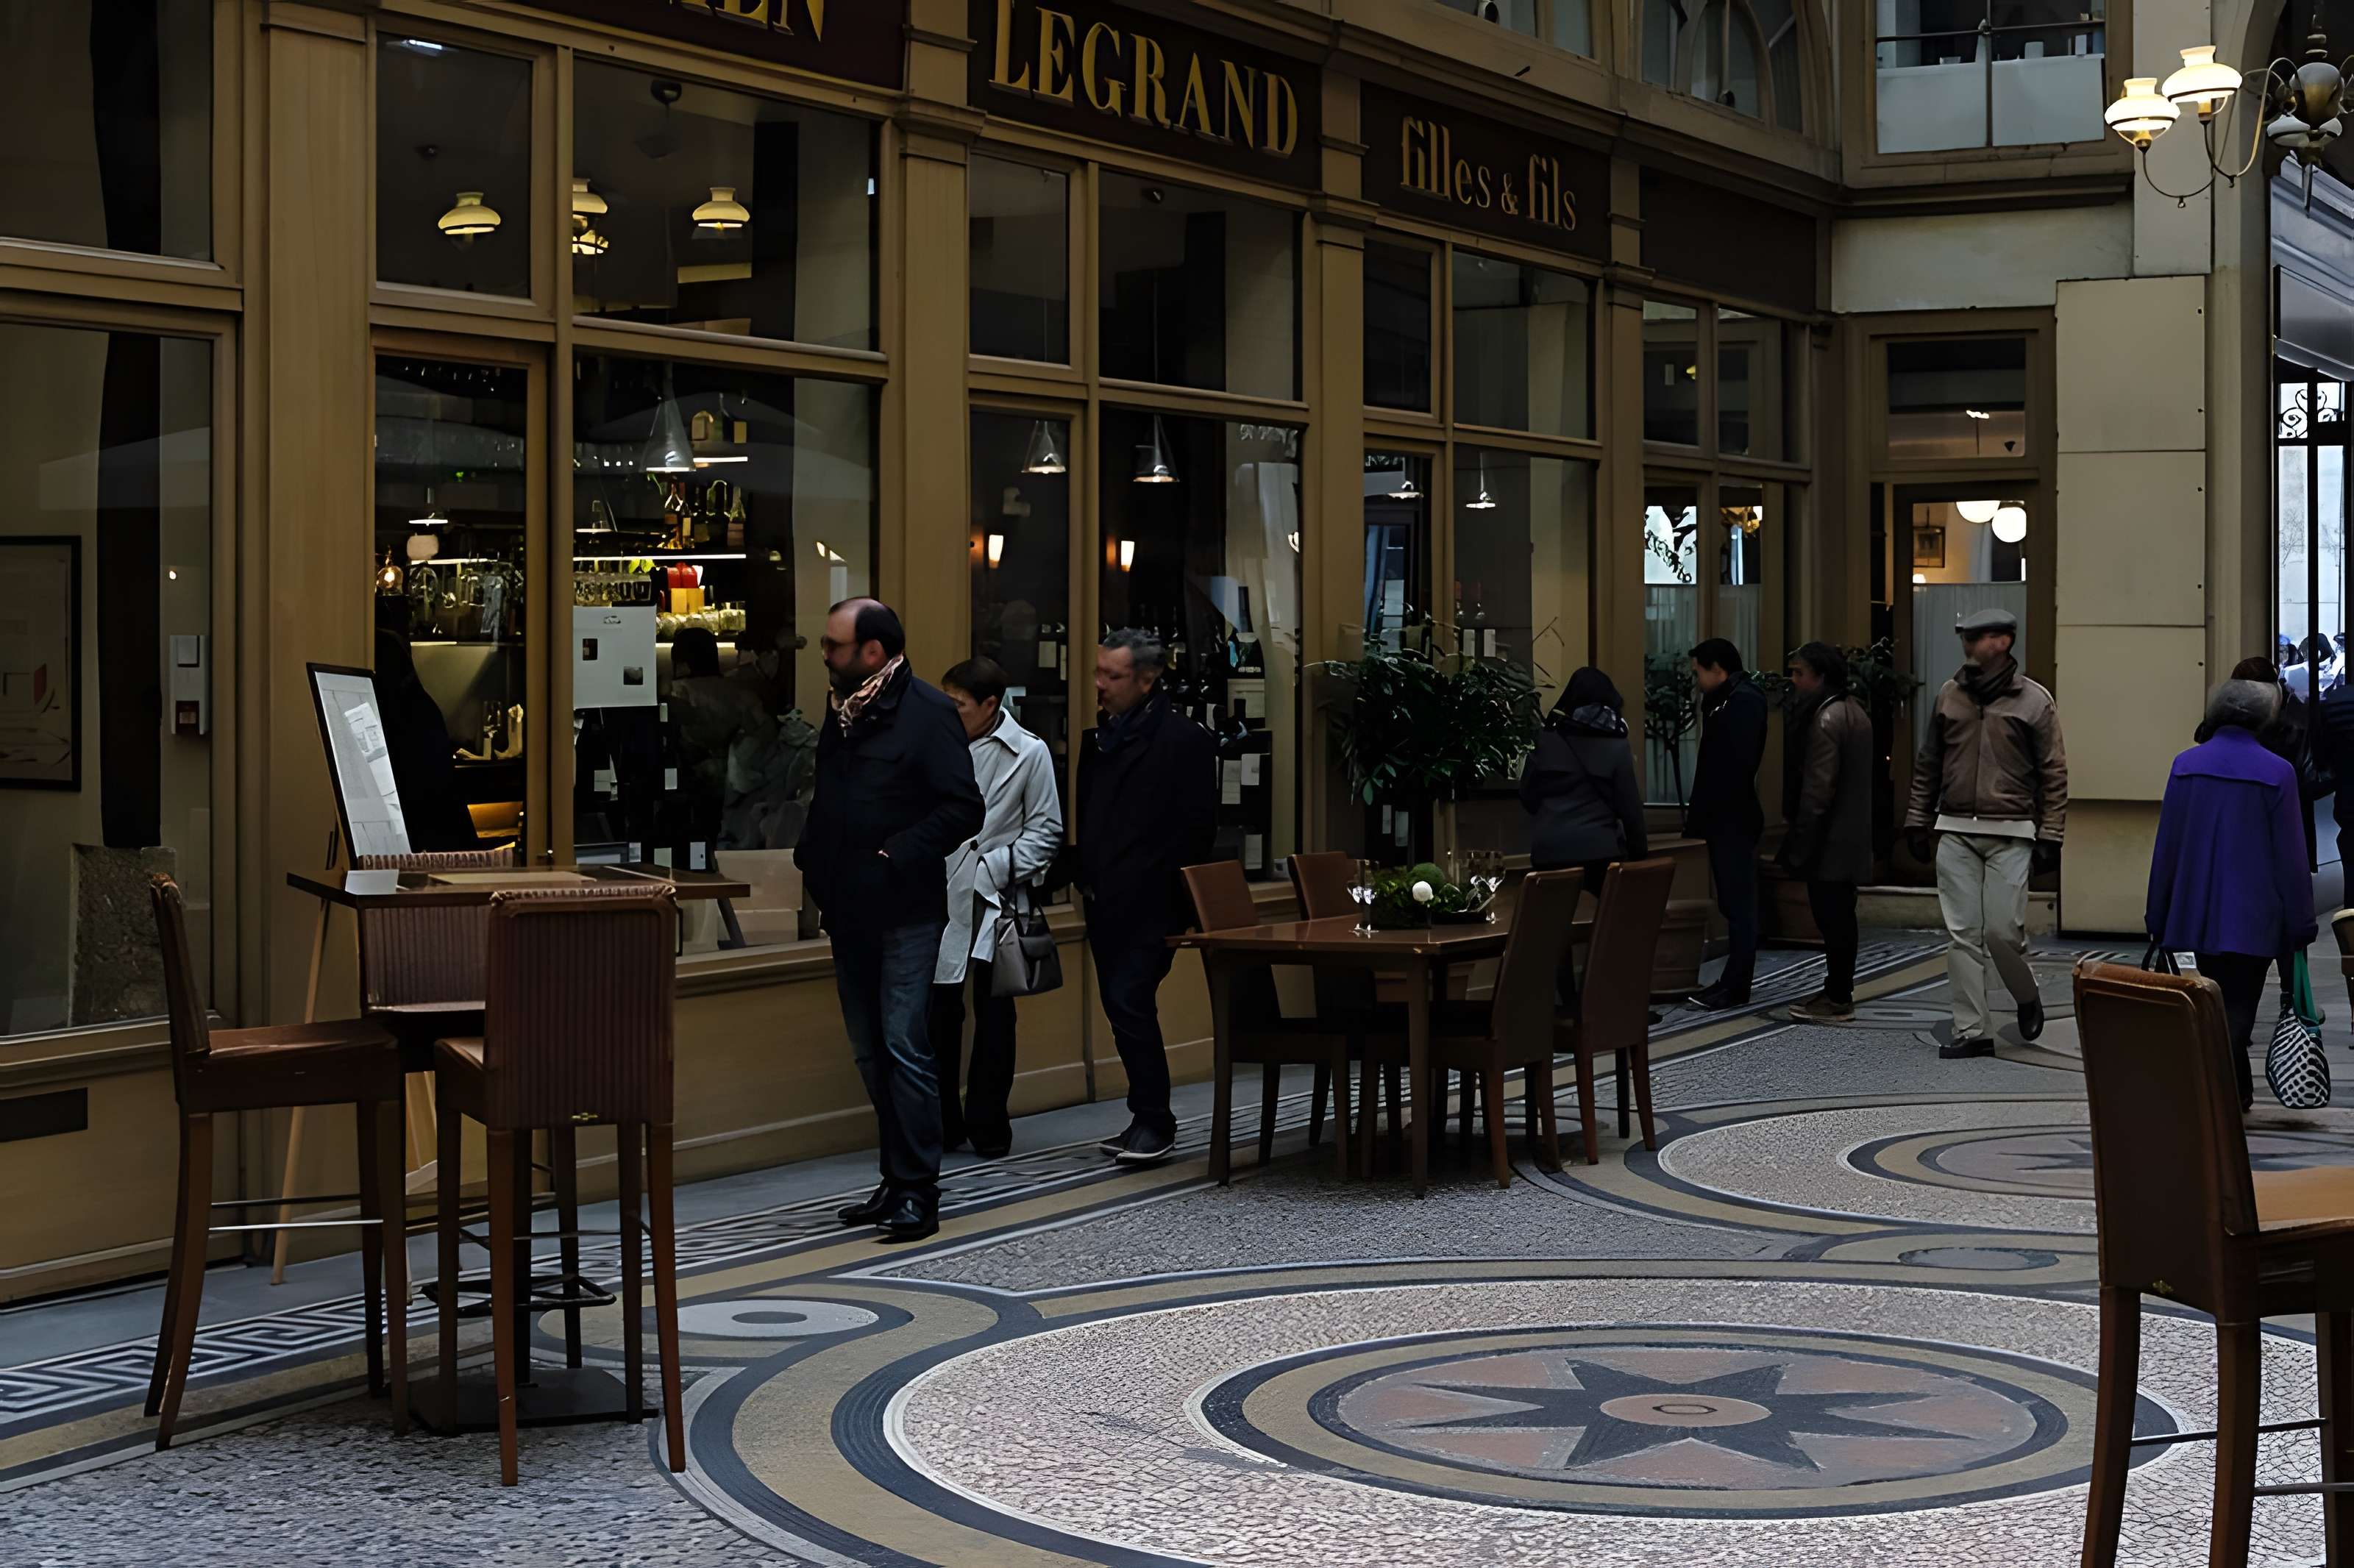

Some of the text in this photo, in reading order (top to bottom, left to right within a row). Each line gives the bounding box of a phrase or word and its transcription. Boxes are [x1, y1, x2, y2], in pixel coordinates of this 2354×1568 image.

[989, 0, 1299, 159] LEGRAND
[1400, 115, 1576, 232] filles & fils
